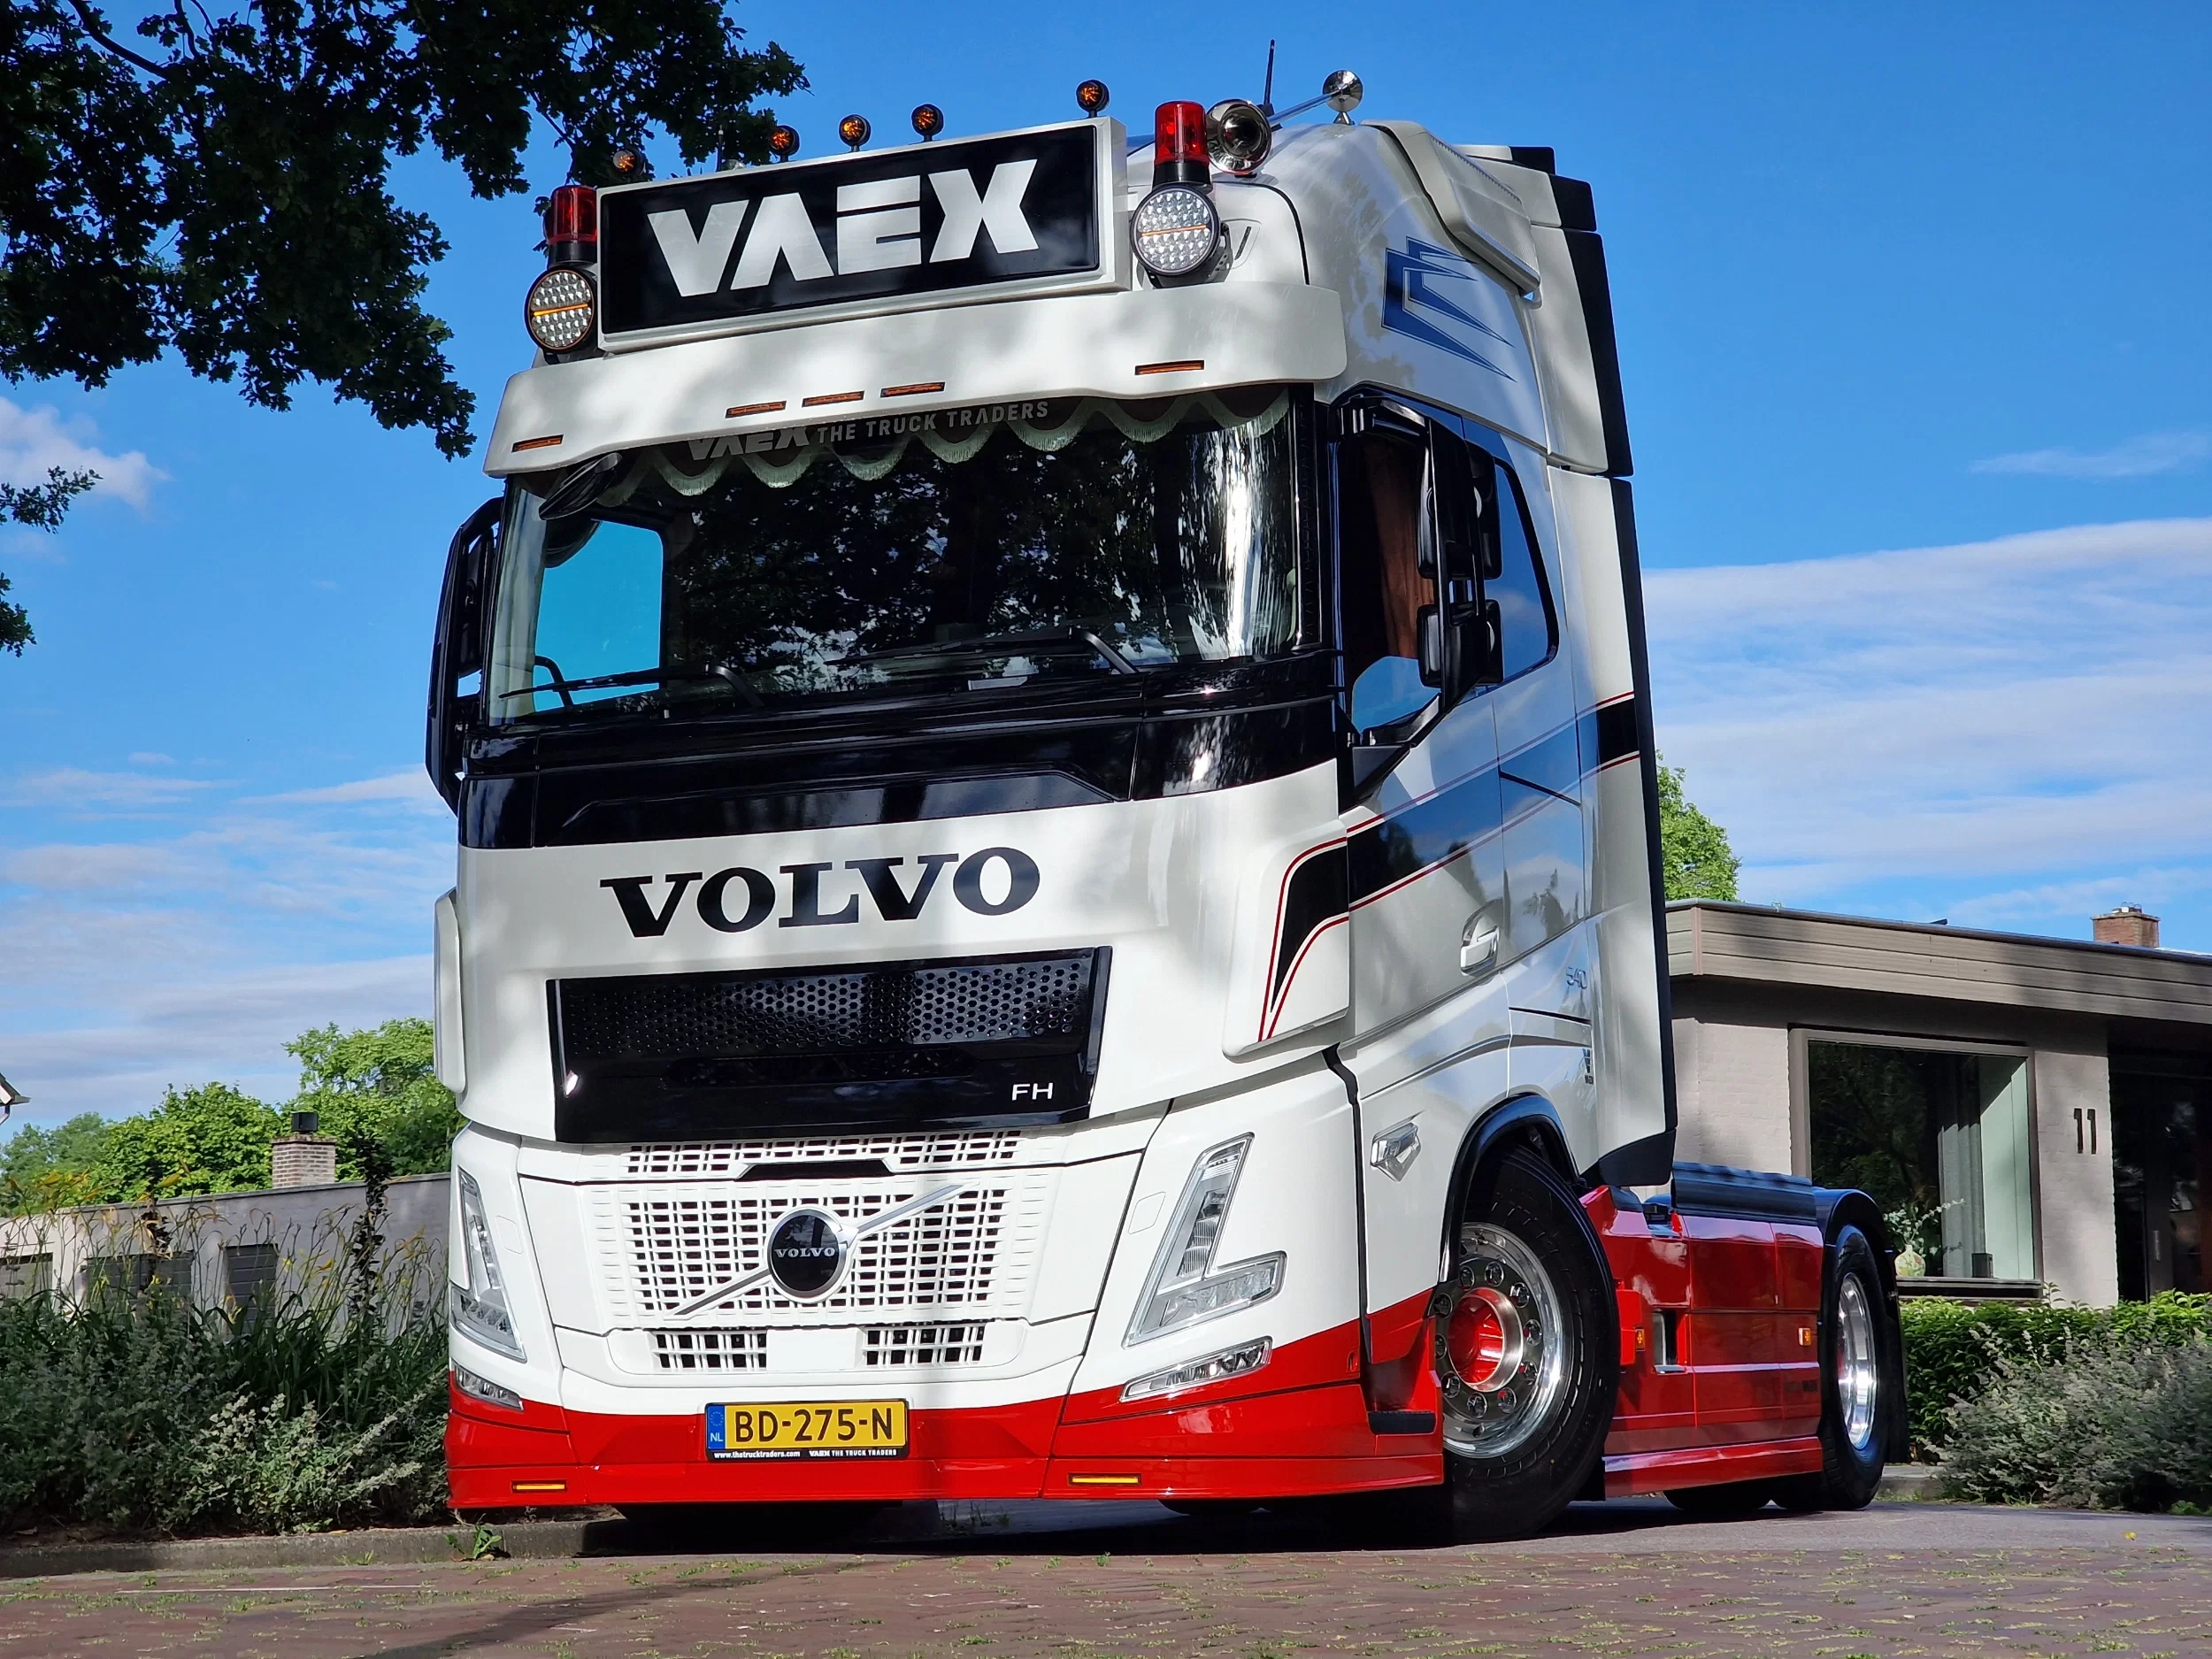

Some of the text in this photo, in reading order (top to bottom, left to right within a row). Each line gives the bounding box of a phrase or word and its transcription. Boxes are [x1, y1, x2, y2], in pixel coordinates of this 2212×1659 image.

[647, 158, 1040, 297] VAEX
[818, 423, 856, 443] THE
[866, 413, 936, 437] TRUCK
[946, 401, 1049, 429] TRADERS
[600, 847, 1041, 938] VOLVO
[1565, 966, 1588, 989] 540
[1011, 1082, 1054, 1102] FH
[2073, 1108, 2097, 1155] 11
[773, 1247, 836, 1258] VOLVO
[710, 1432, 724, 1443] NL
[734, 1407, 893, 1443] BD-275-N
[713, 1450, 801, 1459] www.thetrucktraders.com
